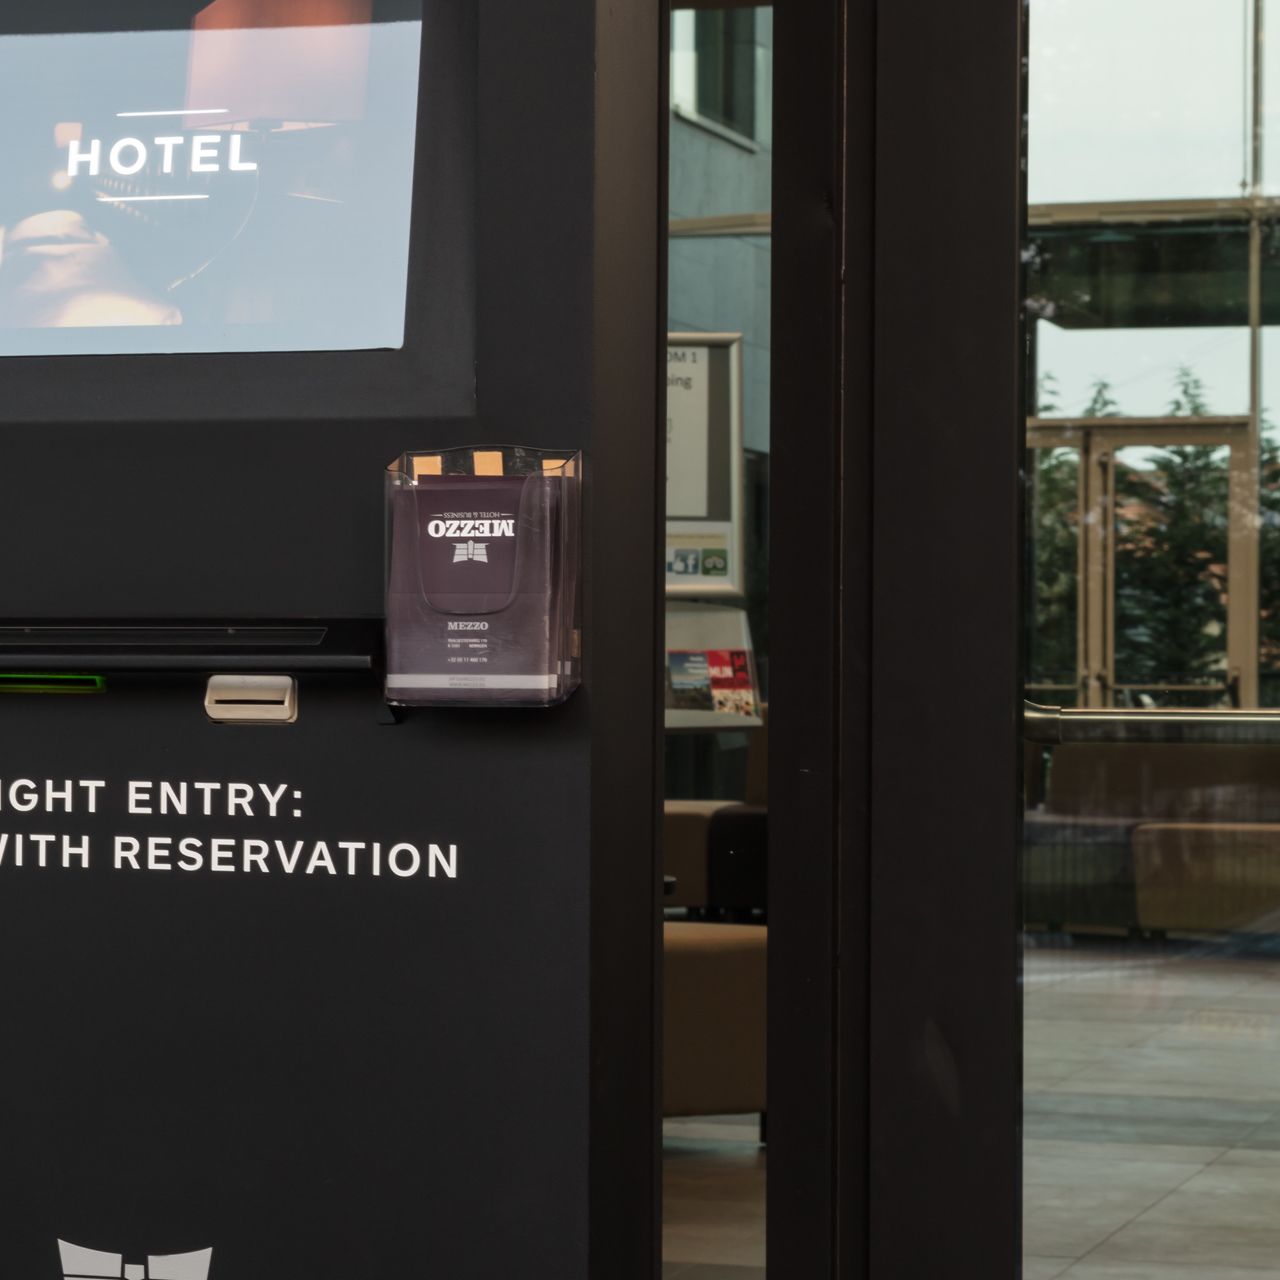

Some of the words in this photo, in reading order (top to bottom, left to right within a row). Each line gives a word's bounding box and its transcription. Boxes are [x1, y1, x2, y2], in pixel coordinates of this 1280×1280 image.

[67, 134, 257, 176] HOTEL
[428, 520, 515, 537] MEZZO
[448, 621, 489, 630] MEZZO
[128, 780, 302, 818] ENTRY:
[114, 836, 457, 879] RESERVATION
